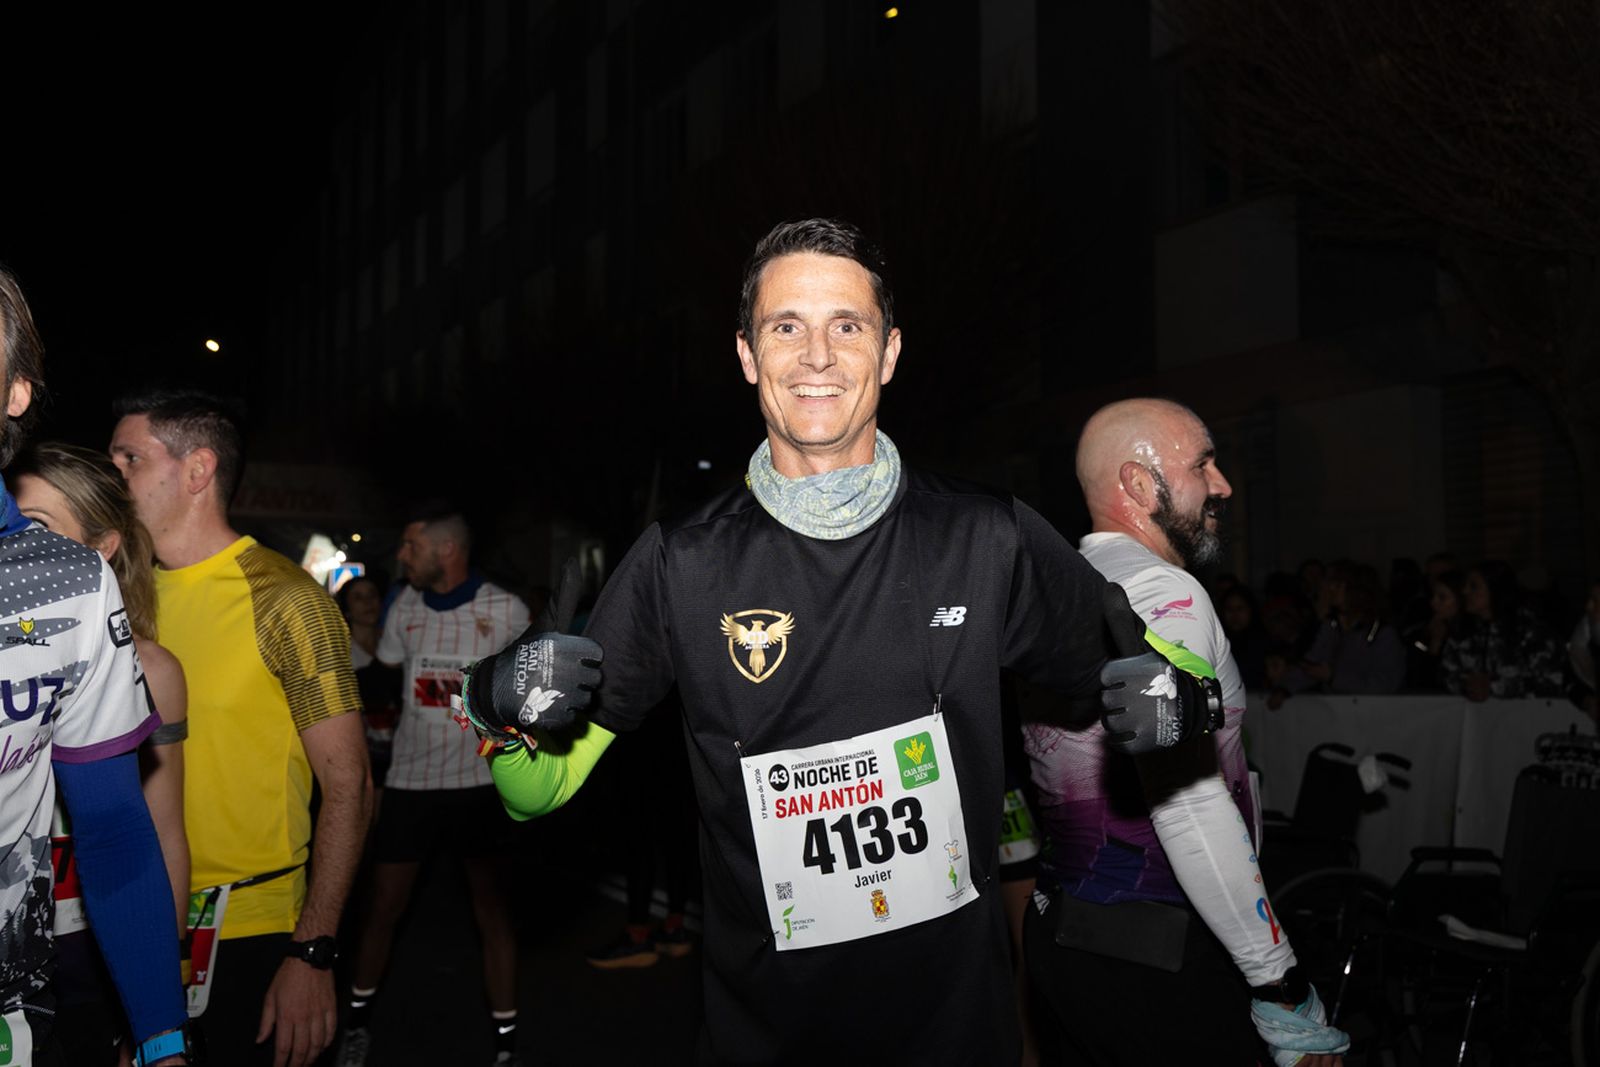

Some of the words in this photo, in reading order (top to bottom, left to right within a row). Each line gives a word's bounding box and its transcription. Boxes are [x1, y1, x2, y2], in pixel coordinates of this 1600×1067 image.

[5, 636, 51, 647] SPALL
[527, 641, 539, 671] SAN
[516, 644, 530, 696] ANTÓN
[791, 760, 814, 770] CARRERA
[815, 757, 834, 767] URBANA
[834, 749, 875, 763] INTERNACIONAL
[793, 763, 852, 789] NOCHE
[855, 756, 879, 778] DE
[769, 769, 788, 785] 43
[775, 793, 814, 819] SAN
[818, 779, 884, 812] ANTÓN
[803, 796, 929, 875] 4133
[854, 869, 893, 889] Javier
